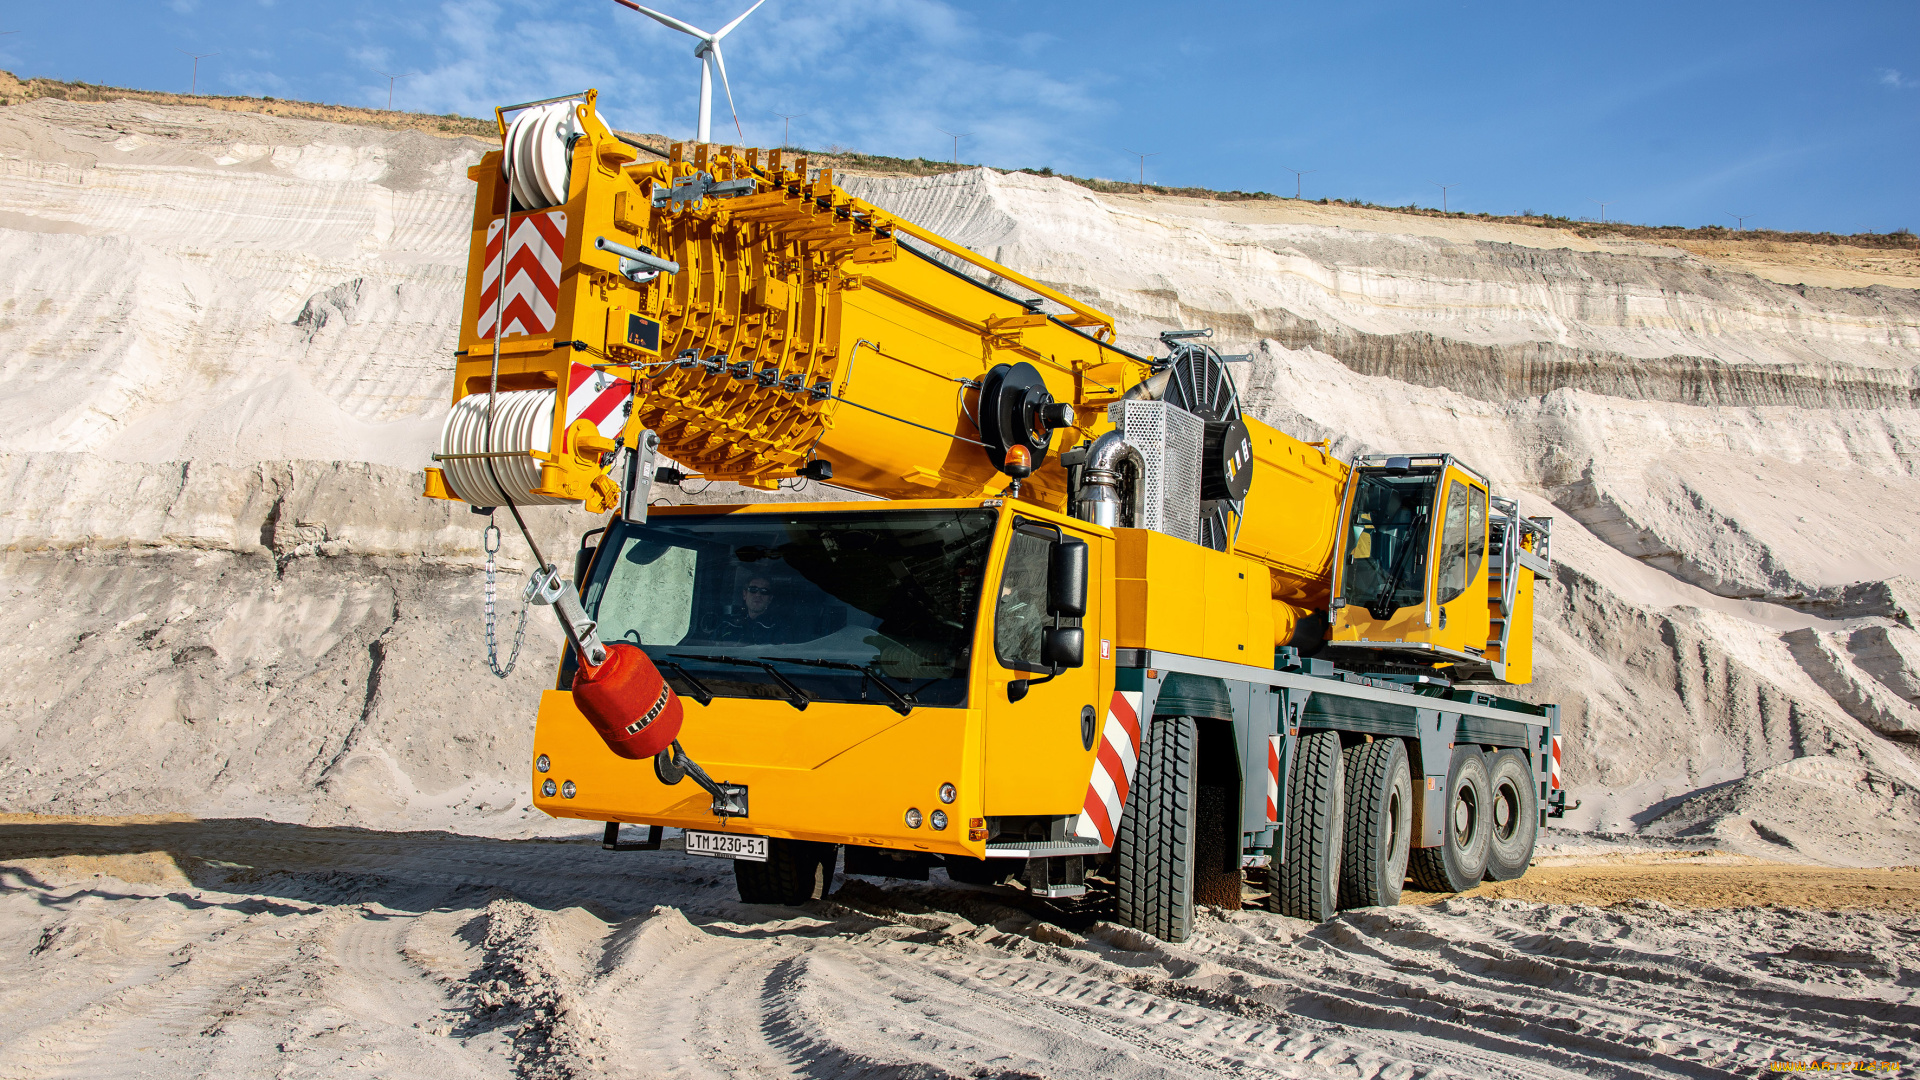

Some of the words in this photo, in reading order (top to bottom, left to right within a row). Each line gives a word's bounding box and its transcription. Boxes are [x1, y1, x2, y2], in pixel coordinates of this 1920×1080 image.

[627, 683, 669, 735] LIEBHER
[688, 834, 710, 850] LTM
[712, 836, 765, 855] 1230-5.1
